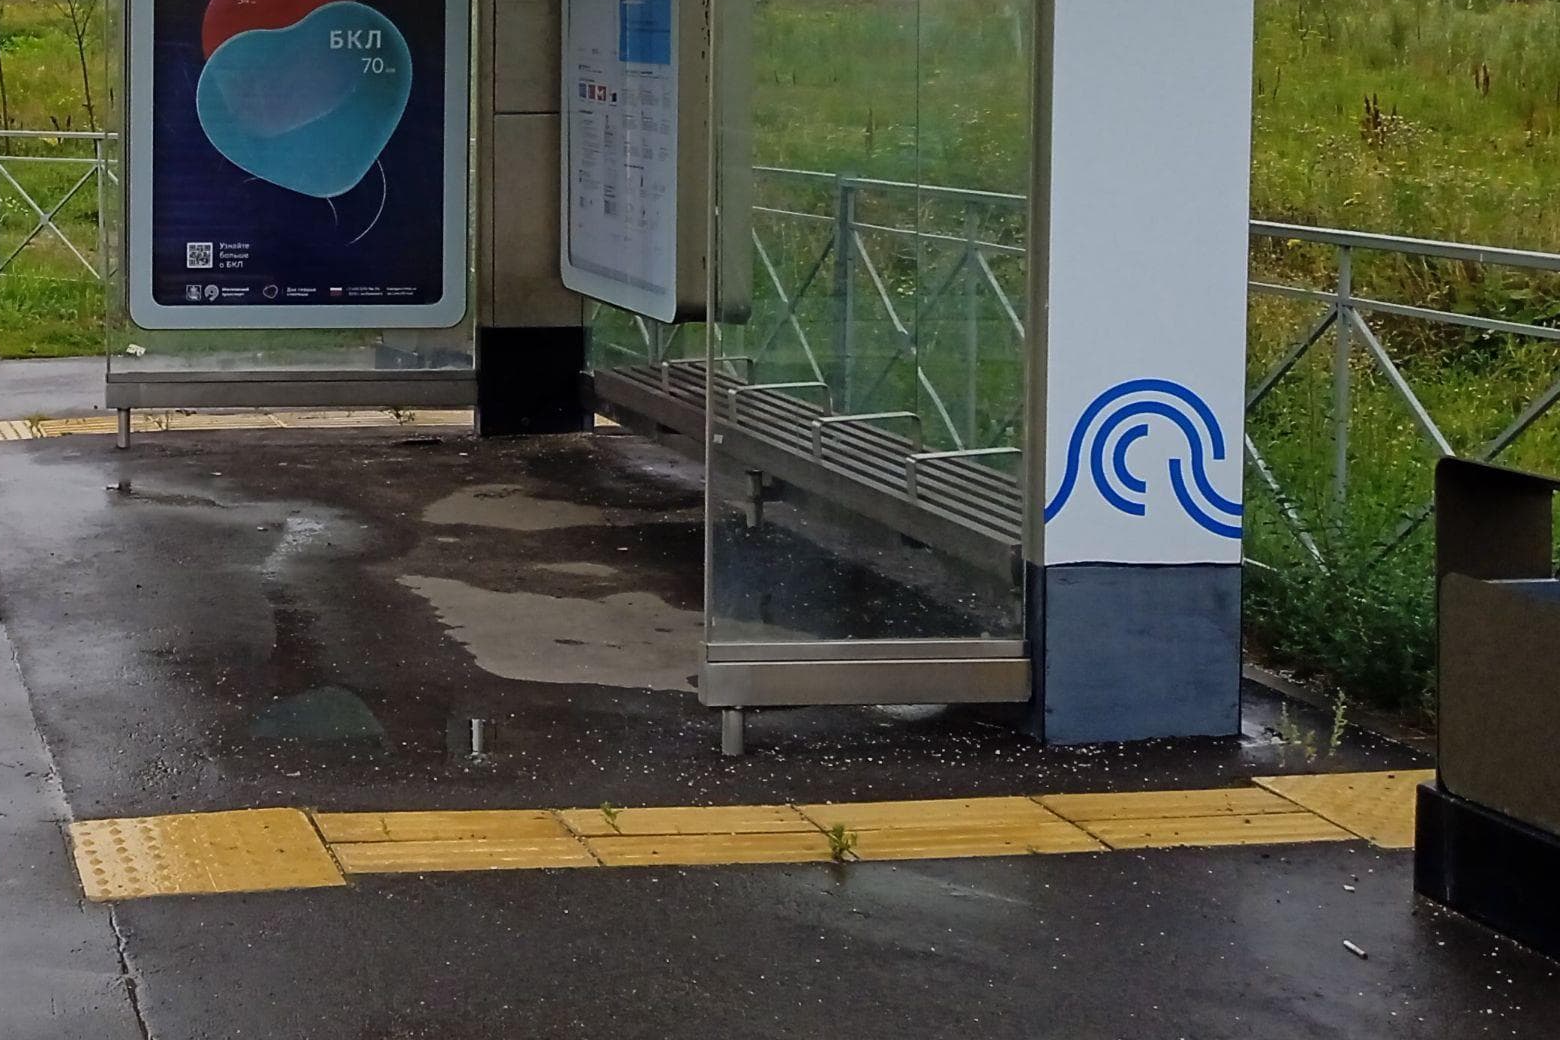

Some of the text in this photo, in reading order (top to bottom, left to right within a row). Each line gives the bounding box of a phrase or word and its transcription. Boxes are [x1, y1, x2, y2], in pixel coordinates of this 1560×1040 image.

[329, 30, 381, 49] БКЛ
[361, 57, 384, 74] 70
[219, 242, 250, 250] Узнайте
